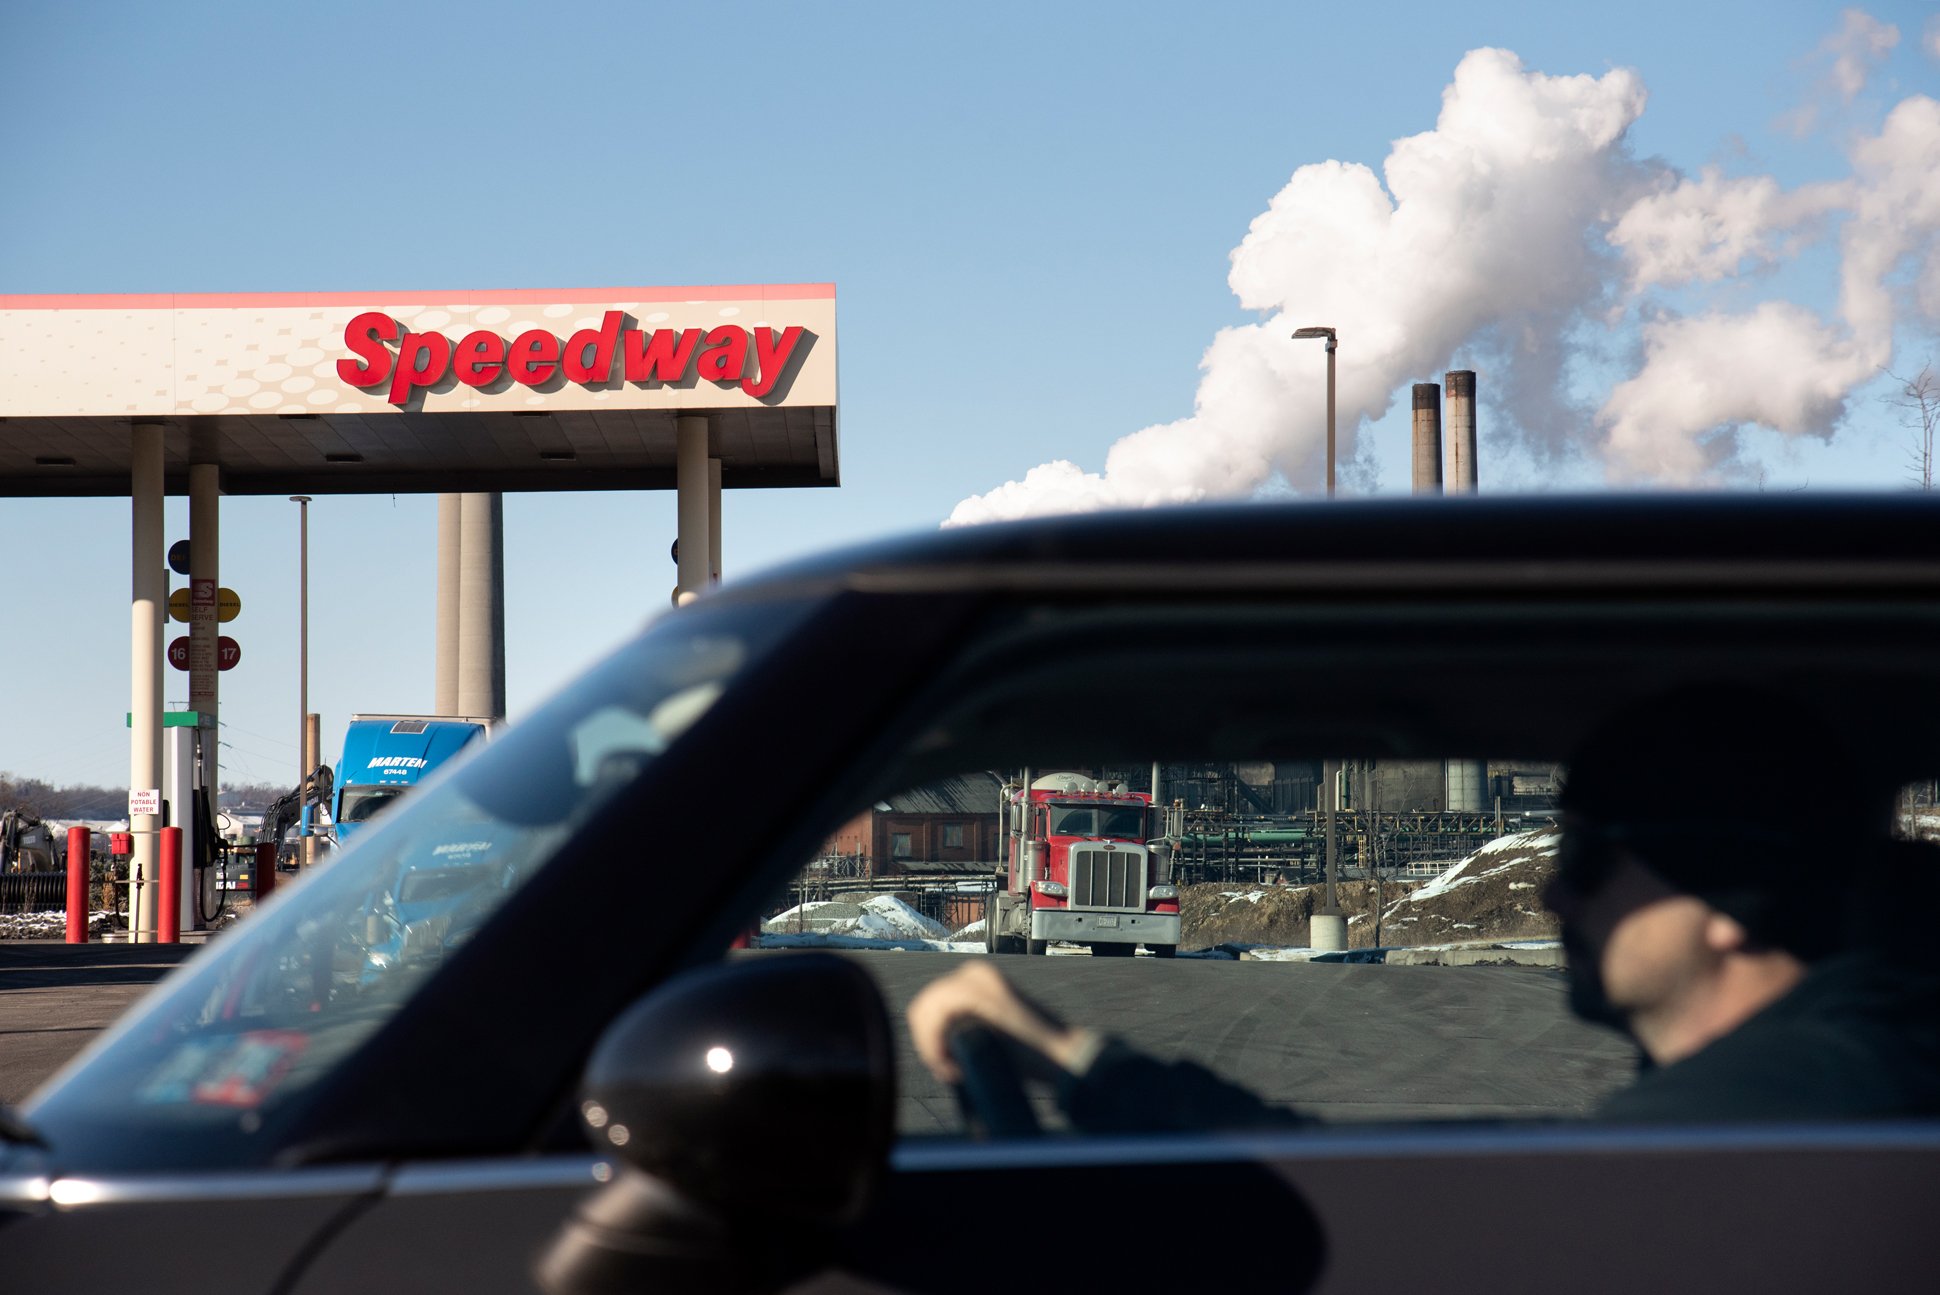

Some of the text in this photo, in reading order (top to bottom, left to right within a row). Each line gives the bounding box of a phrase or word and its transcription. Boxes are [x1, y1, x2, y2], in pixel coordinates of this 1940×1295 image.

[336, 310, 805, 405] Speedway
[171, 648, 186, 660] 16
[221, 648, 236, 660] 17
[367, 756, 428, 769] MARTEN
